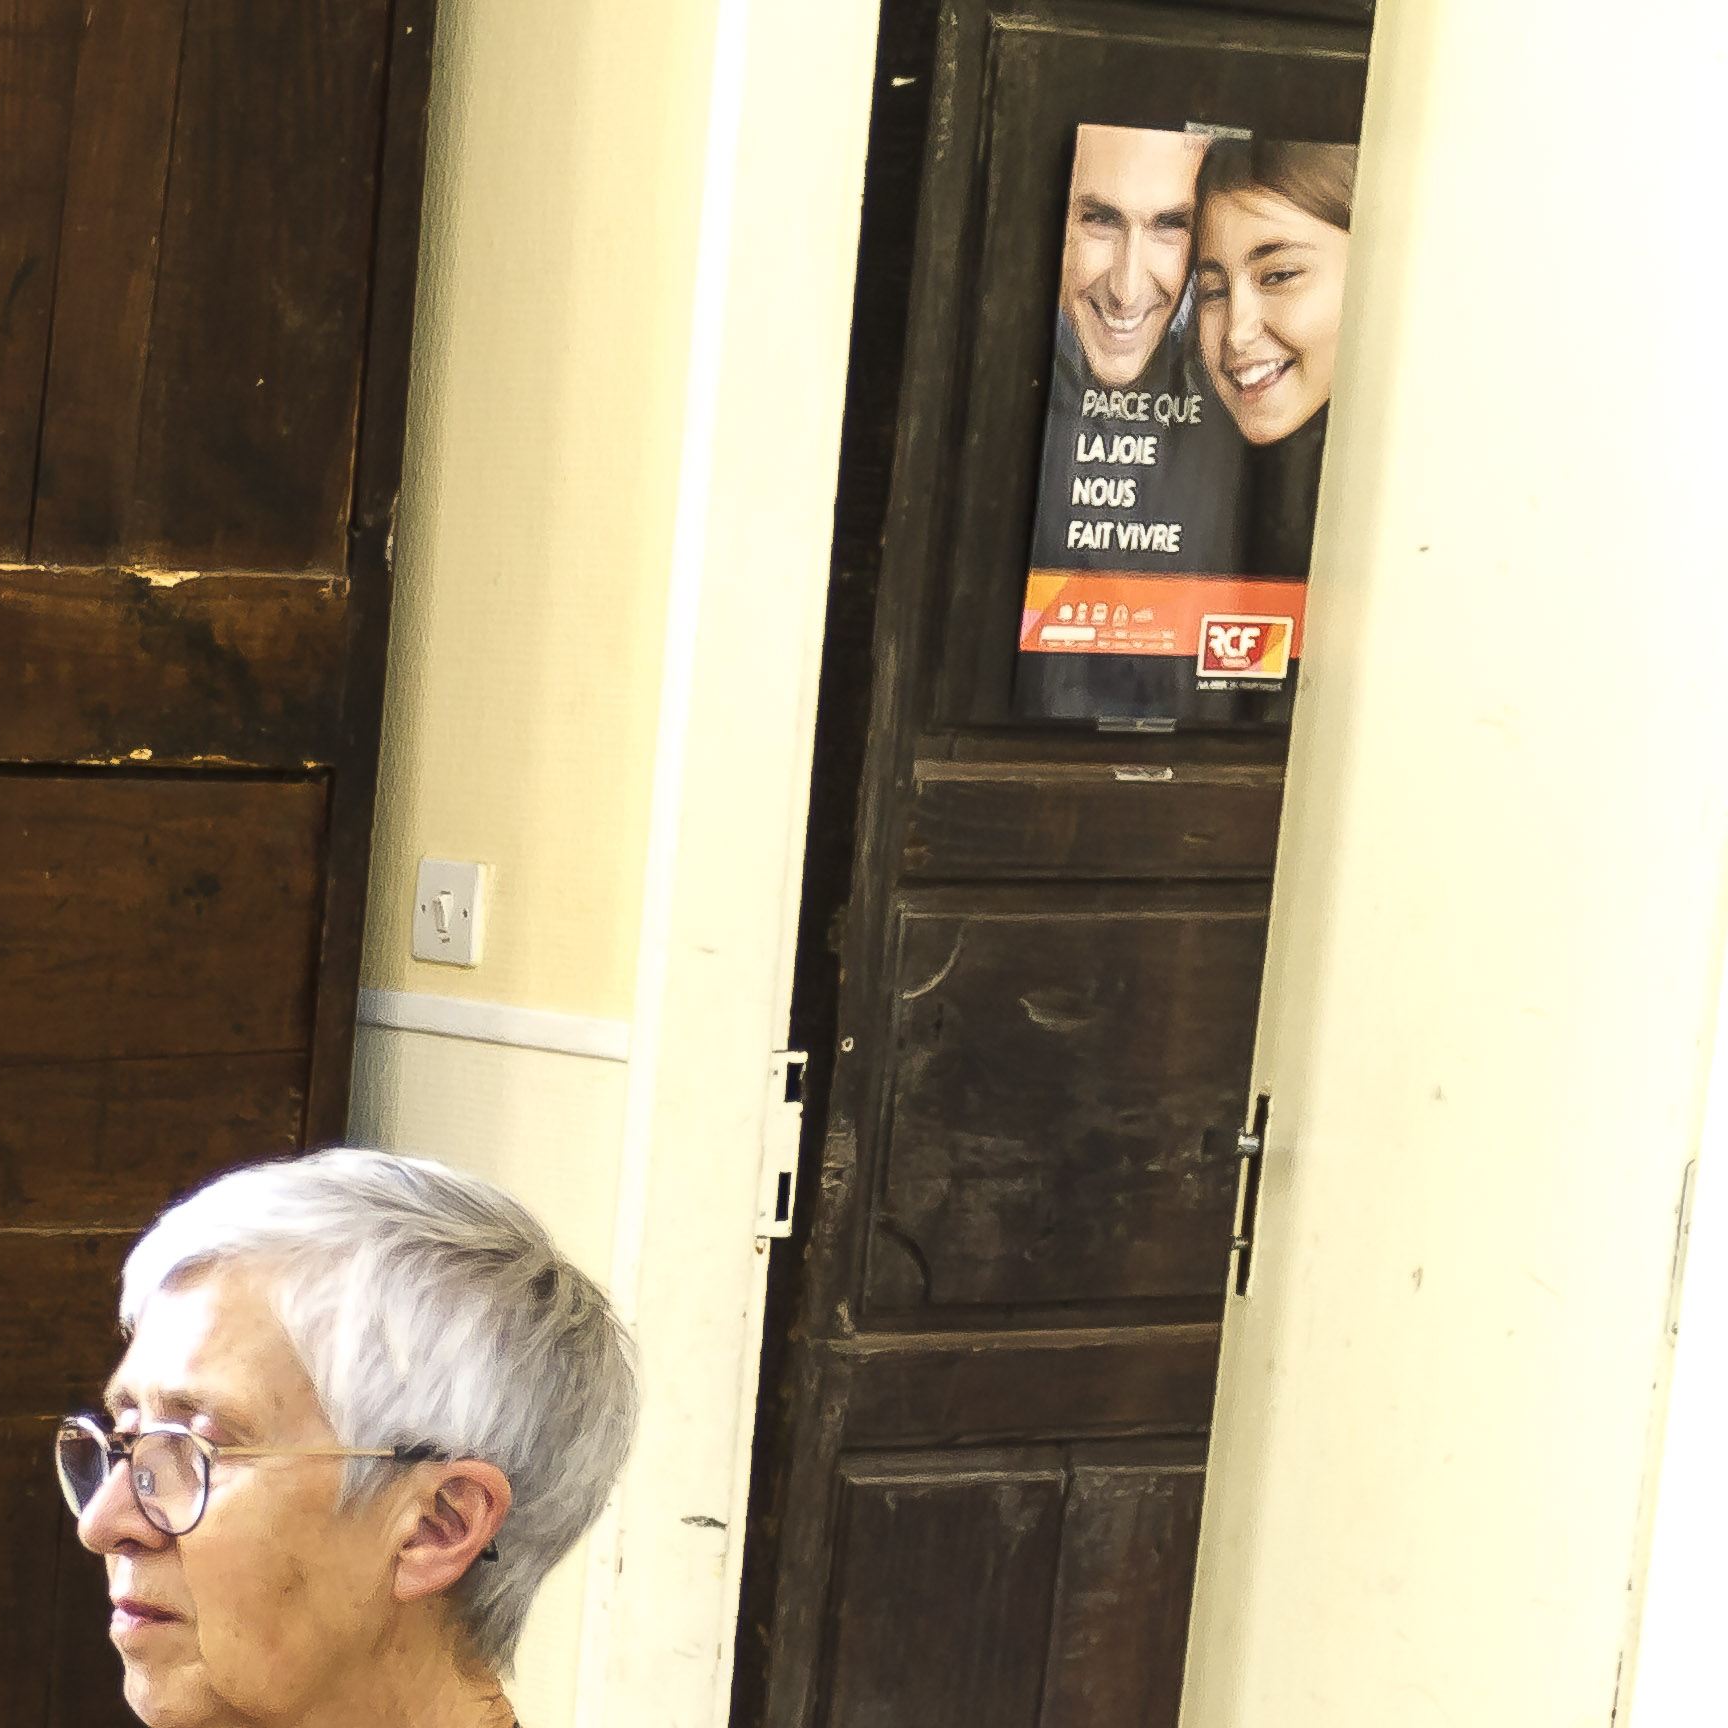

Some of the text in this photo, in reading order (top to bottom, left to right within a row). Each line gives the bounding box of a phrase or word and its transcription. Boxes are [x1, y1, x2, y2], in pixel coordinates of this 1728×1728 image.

[1082, 389, 1203, 428] PARCE QUE
[1076, 433, 1158, 465] LA JOIE
[1071, 477, 1137, 507] NOUS
[1067, 520, 1182, 552] FAIT VIVRE
[1208, 625, 1261, 658] RCF
